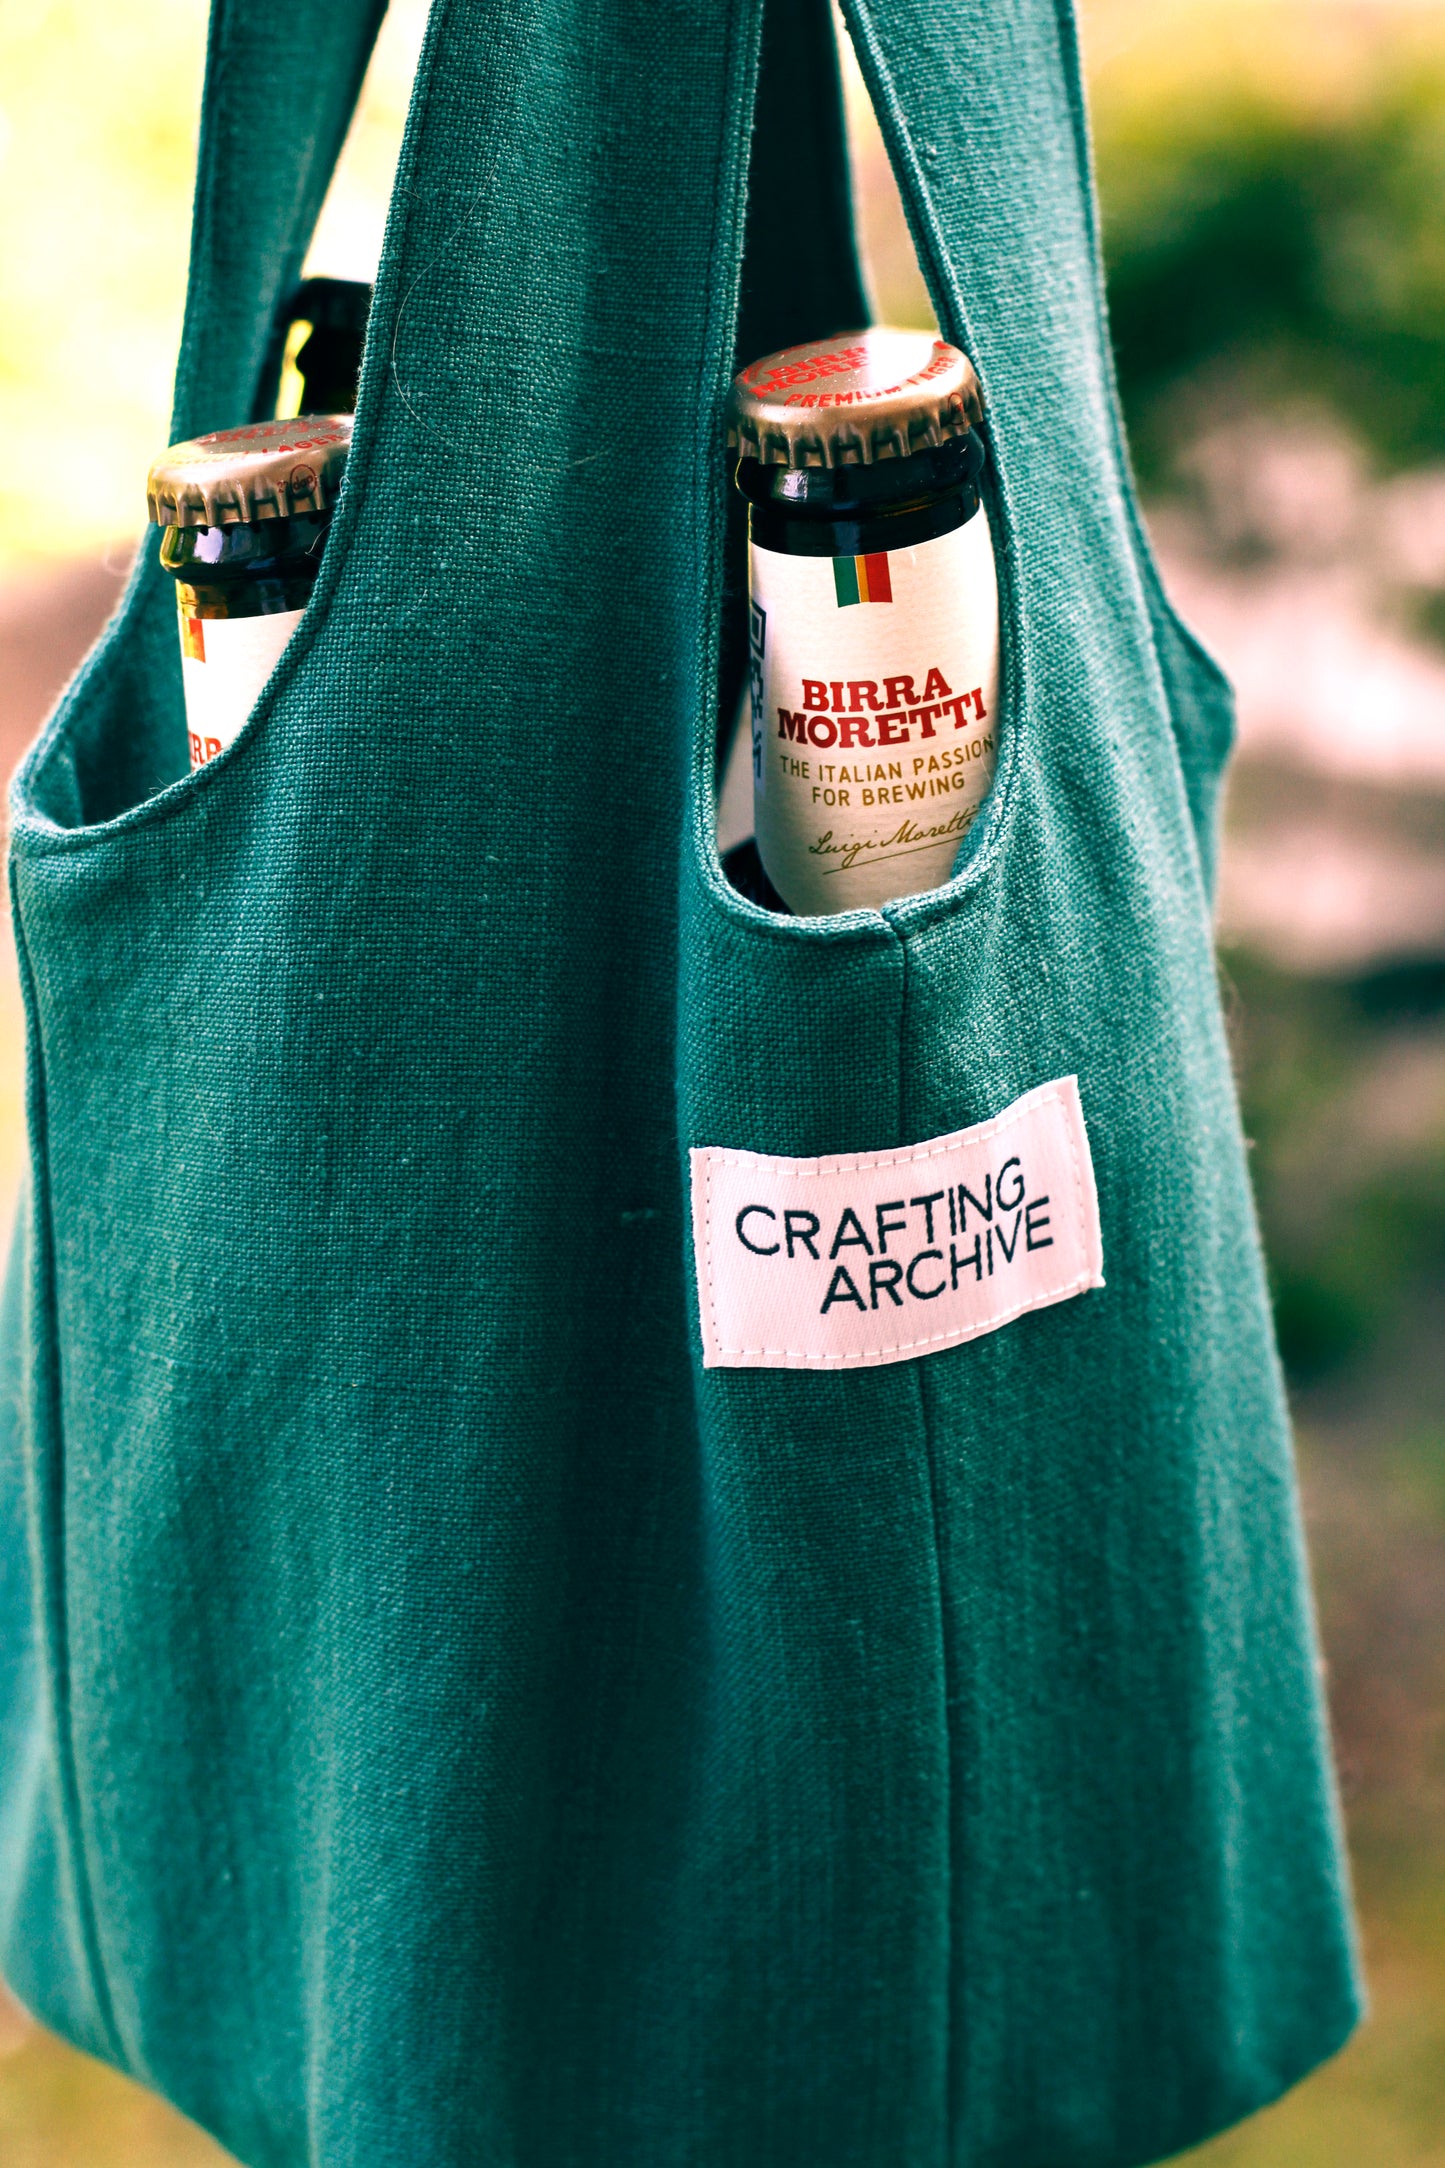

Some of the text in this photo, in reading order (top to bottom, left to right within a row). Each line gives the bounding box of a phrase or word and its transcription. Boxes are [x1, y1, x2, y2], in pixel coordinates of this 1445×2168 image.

[765, 347, 866, 379] BIRR
[262, 433, 344, 453] AGER
[802, 667, 952, 713] BIRRA
[777, 687, 988, 749] MORETTI
[779, 733, 994, 784] THE ITALIAN PASSION
[812, 771, 966, 807] FOR BREWING
[808, 830, 877, 869] Luigi
[735, 1156, 1026, 1261] CRAFTING
[820, 1196, 1055, 1315] ARCHIVE
